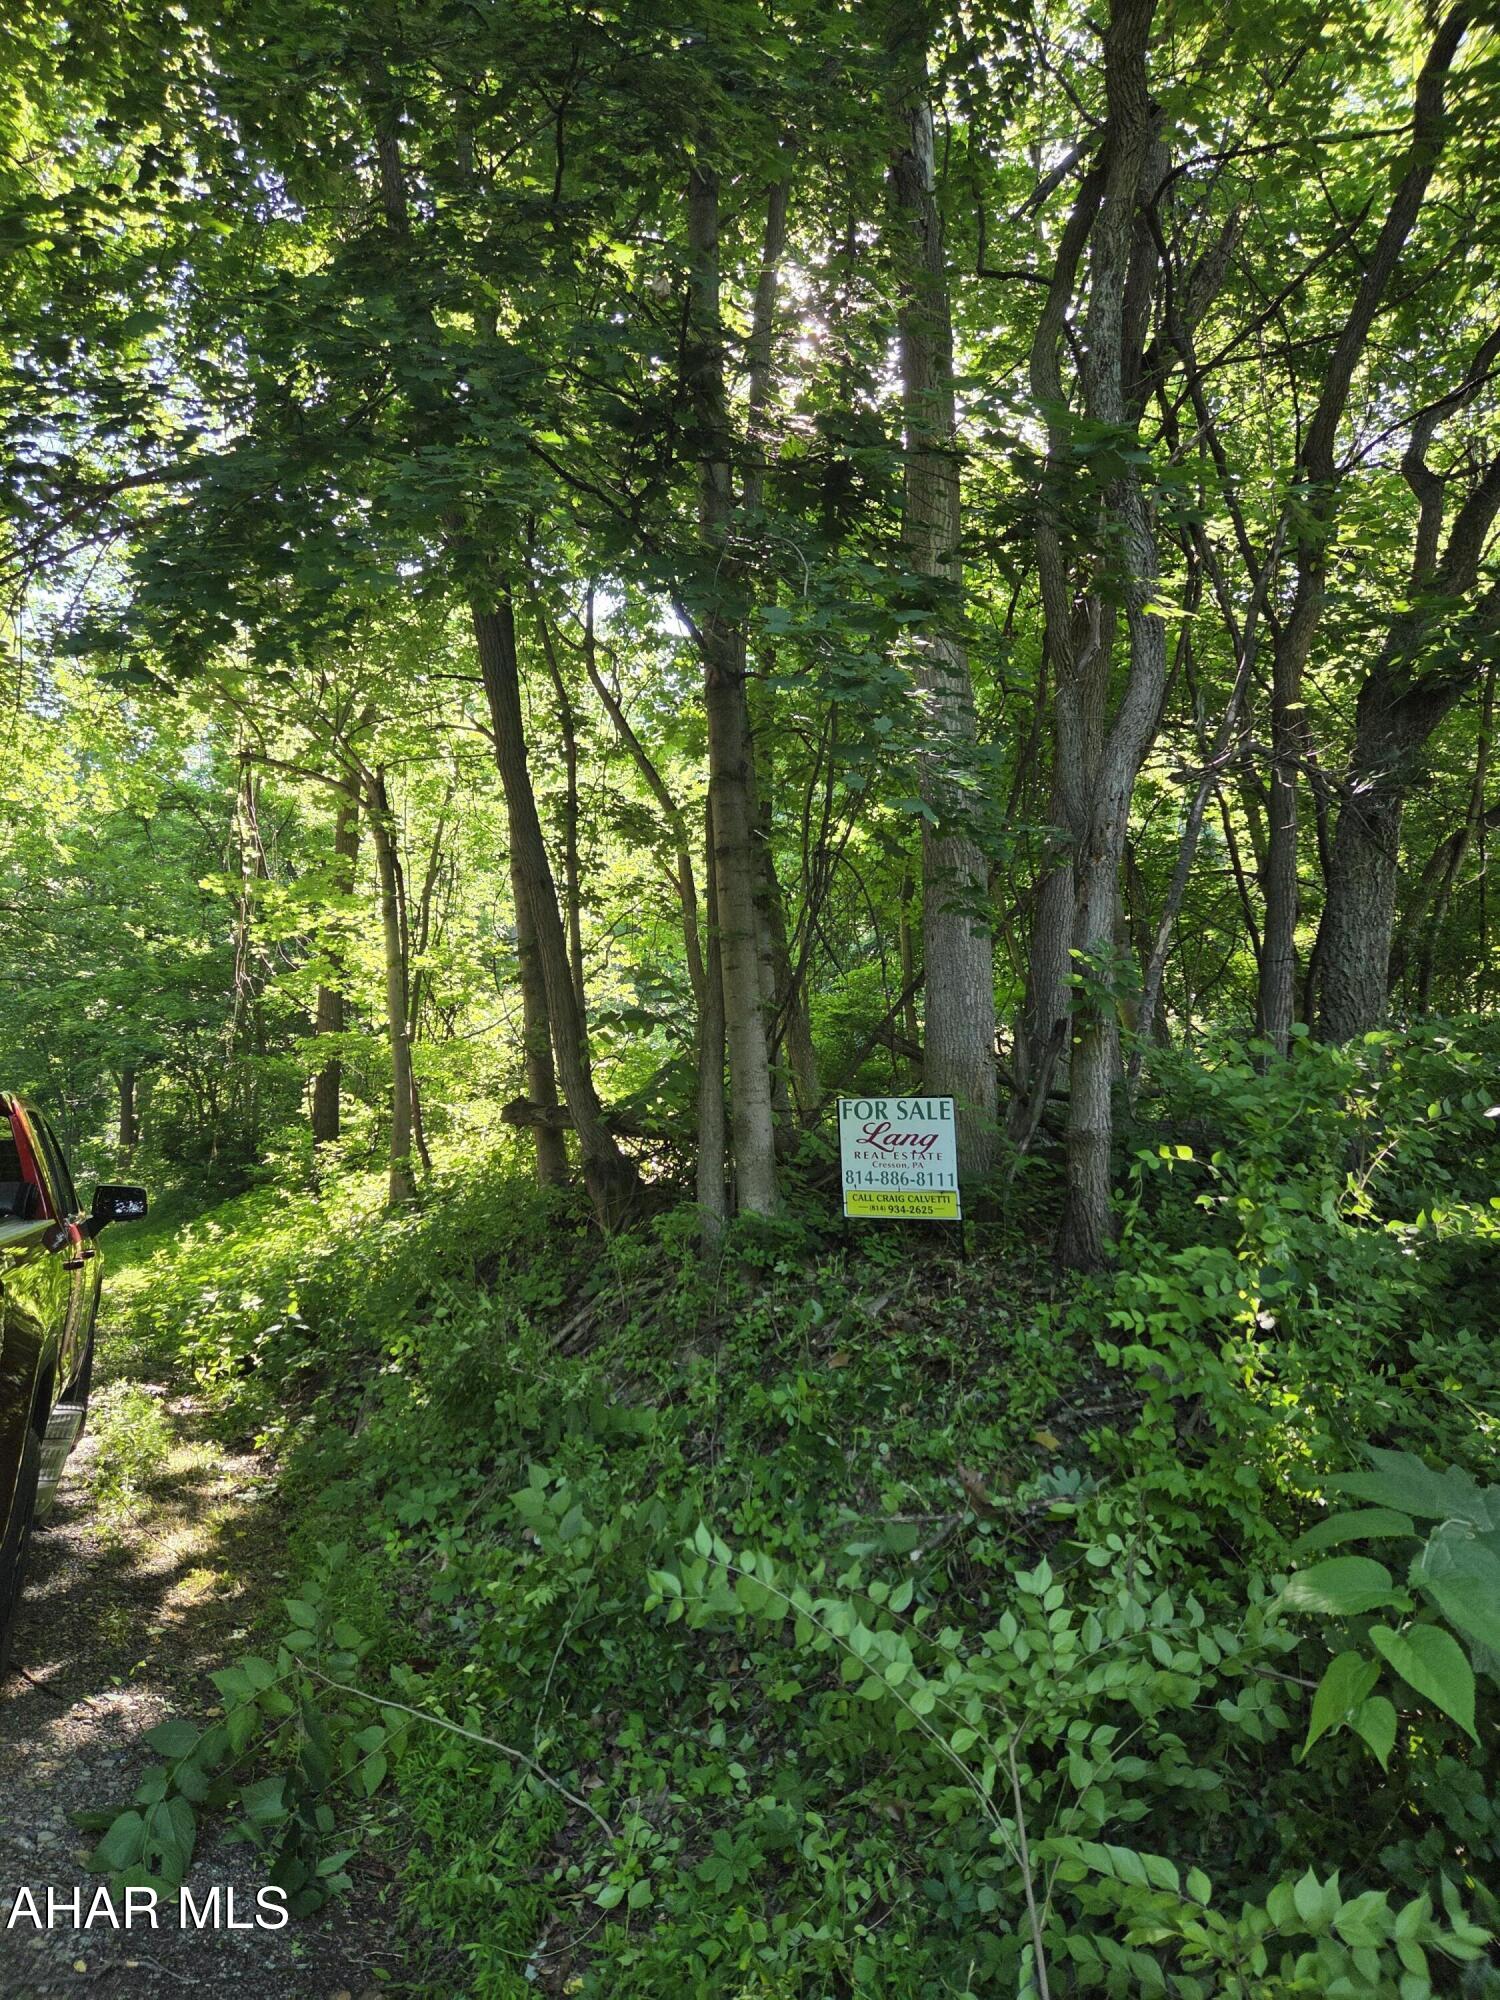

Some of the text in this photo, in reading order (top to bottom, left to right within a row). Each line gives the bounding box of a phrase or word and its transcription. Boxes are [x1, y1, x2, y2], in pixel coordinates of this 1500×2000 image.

[842, 1100, 951, 1120] FOR SALE
[856, 1121, 939, 1156] Lang
[854, 1151, 943, 1161] REAL ESTATE
[872, 1160, 924, 1169] Cresson, PA
[845, 1170, 954, 1187] 814-886-8111
[852, 1193, 951, 1204] CALL CRAIG CALVETTI
[869, 1204, 934, 1214] (814) 934-2625
